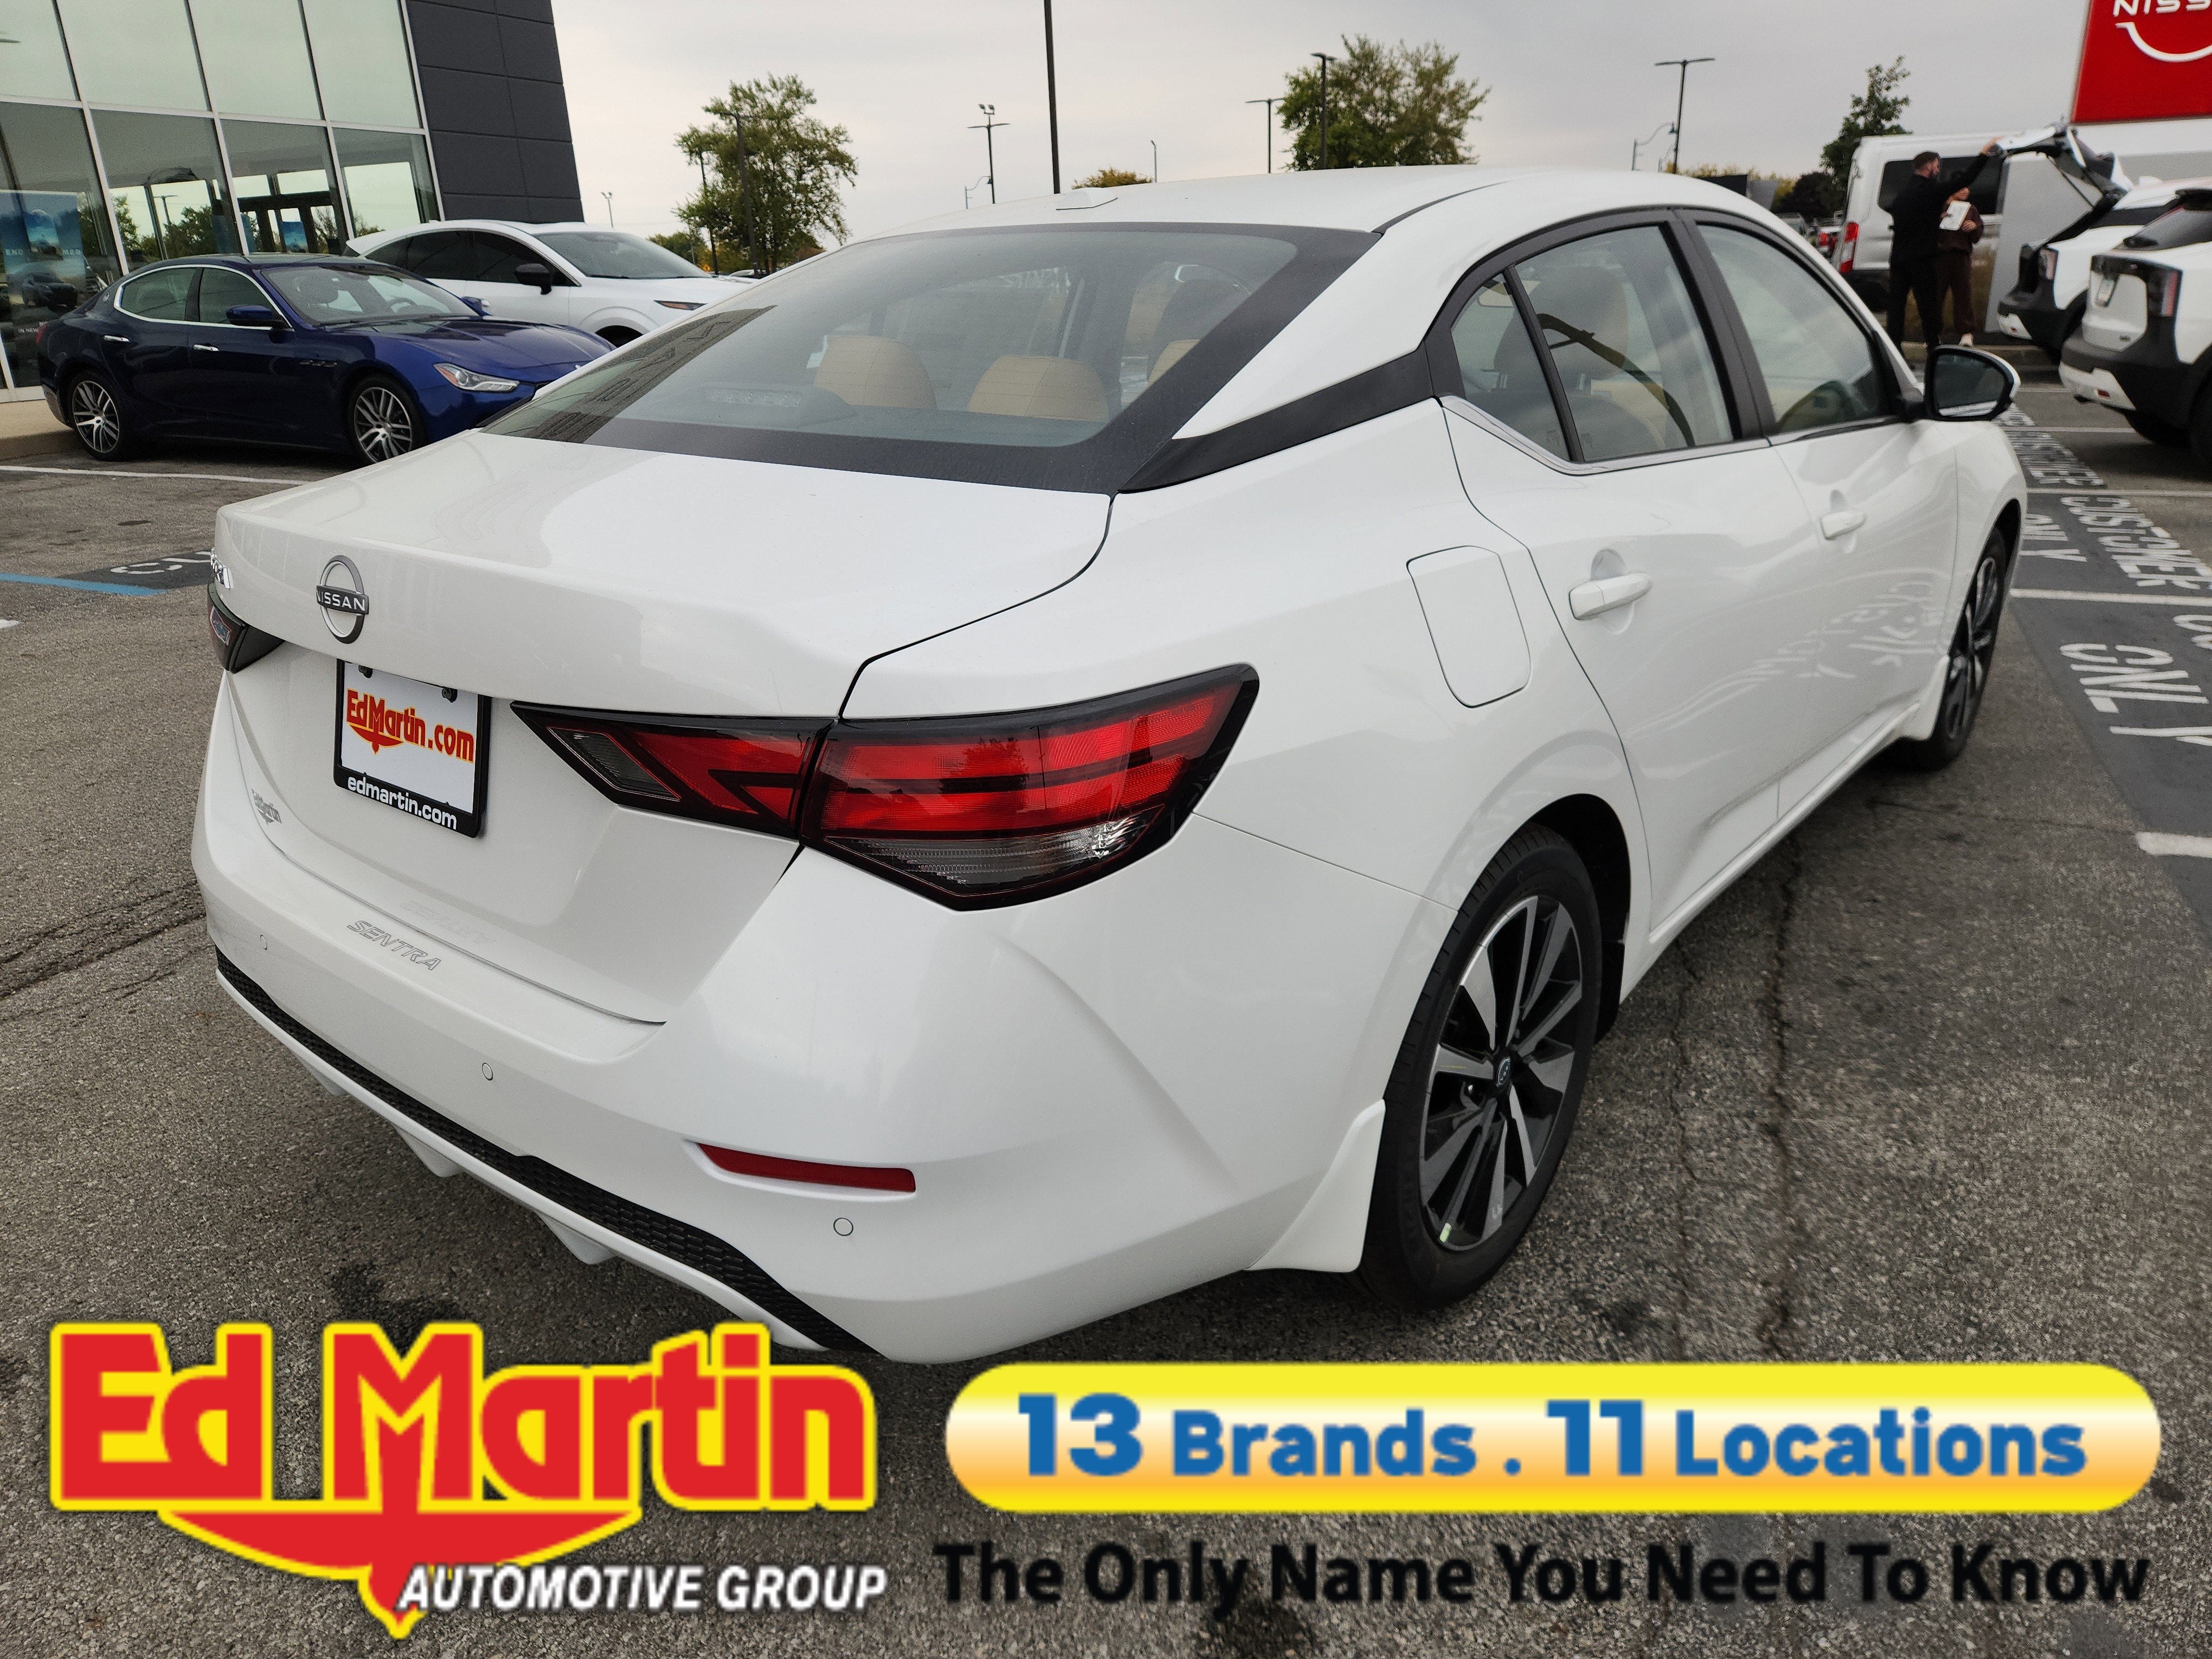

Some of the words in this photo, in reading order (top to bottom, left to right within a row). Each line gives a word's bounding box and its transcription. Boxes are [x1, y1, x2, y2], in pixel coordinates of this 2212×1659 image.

[317, 589, 365, 612] NISSAN
[348, 776, 457, 830] edmartin.com
[347, 920, 441, 970] SENTRA
